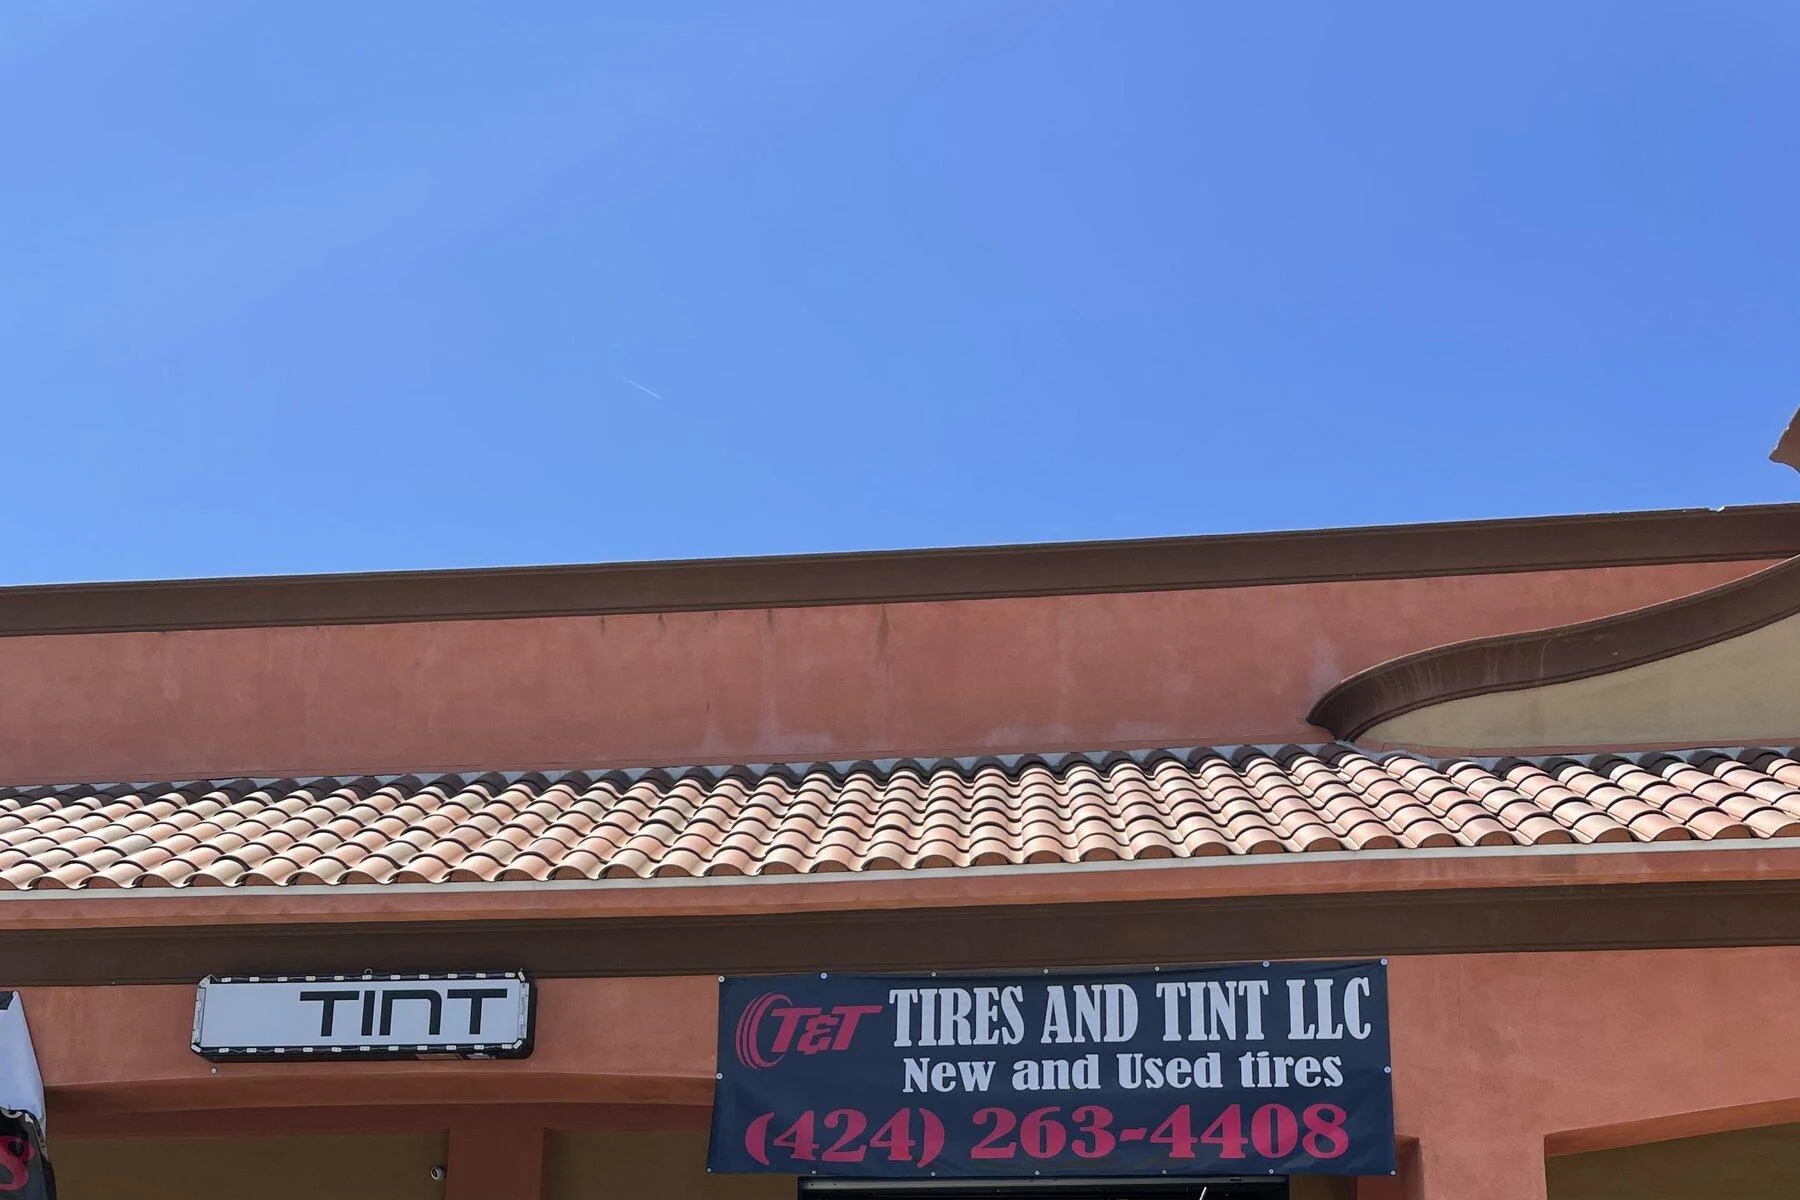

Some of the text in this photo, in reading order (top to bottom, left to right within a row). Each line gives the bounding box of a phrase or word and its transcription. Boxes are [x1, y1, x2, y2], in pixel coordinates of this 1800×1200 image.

[299, 988, 508, 1037] TINT
[769, 1005, 883, 1056] T&T
[888, 976, 1372, 1047] TIRES AND TINT LLC
[902, 1050, 1344, 1093] New and Used tires
[744, 1103, 1350, 1167] (424) 263-4408
